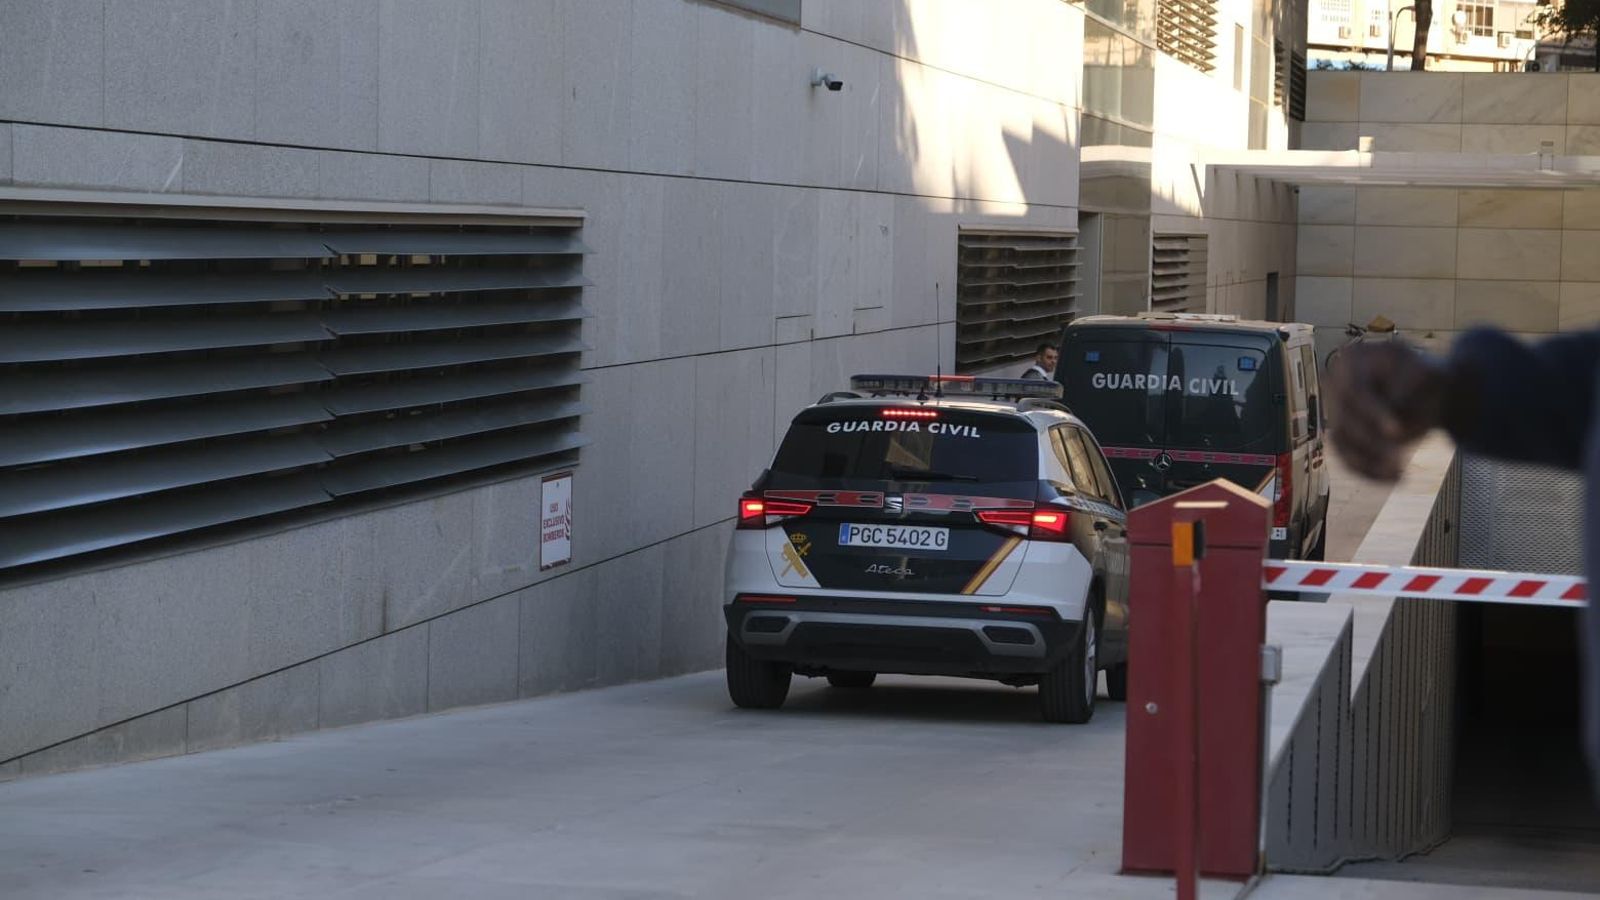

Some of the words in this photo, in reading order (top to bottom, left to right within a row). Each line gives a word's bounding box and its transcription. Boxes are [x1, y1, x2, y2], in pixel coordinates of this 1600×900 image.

[1092, 373, 1182, 390] GUARDIA
[1189, 378, 1239, 395] CIVIL
[826, 421, 920, 433] GUARDIA
[927, 423, 980, 438] CIVIL
[849, 527, 882, 544] PGC
[886, 528, 931, 546] 5402
[935, 531, 945, 547] G
[865, 564, 915, 575] Ateca
